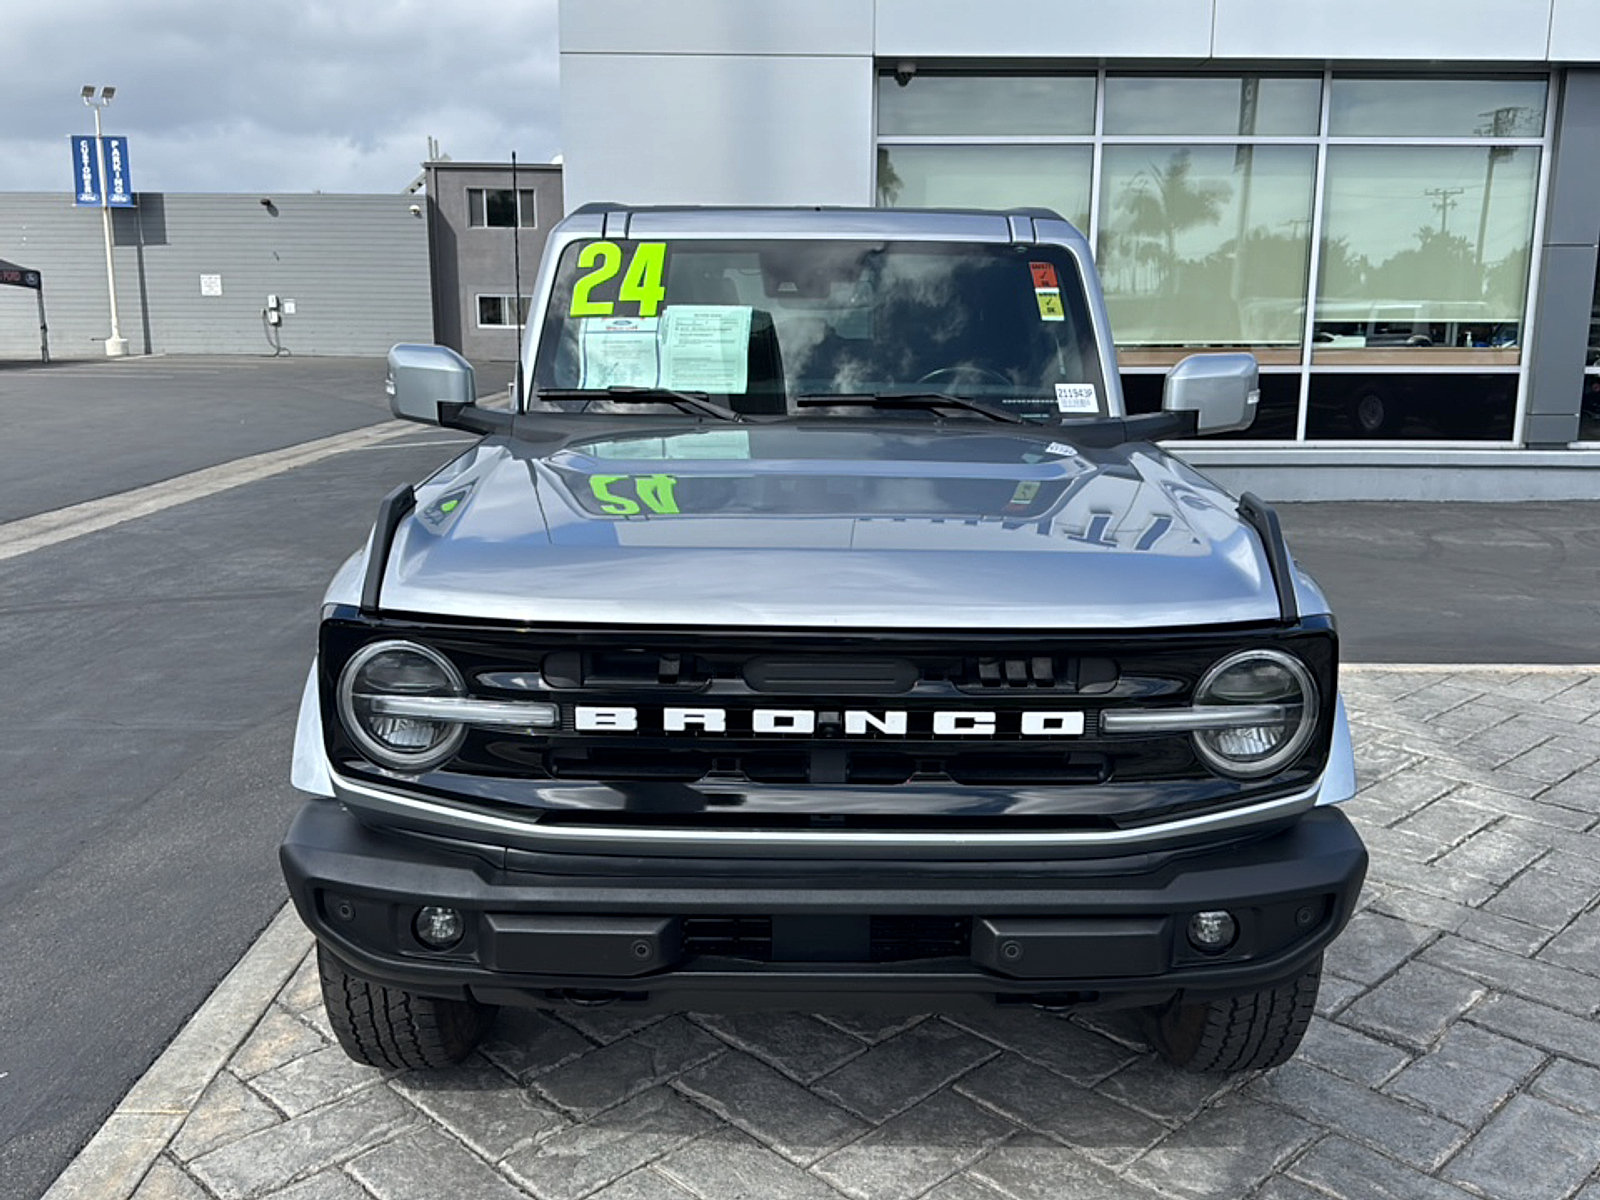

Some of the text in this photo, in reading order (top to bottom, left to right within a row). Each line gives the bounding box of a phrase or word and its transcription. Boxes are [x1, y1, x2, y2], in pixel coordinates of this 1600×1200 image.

[79, 140, 92, 193] CUSTOMER
[111, 140, 124, 193] PARKING
[570, 241, 667, 317] 24
[575, 706, 1084, 736] BRONCO
